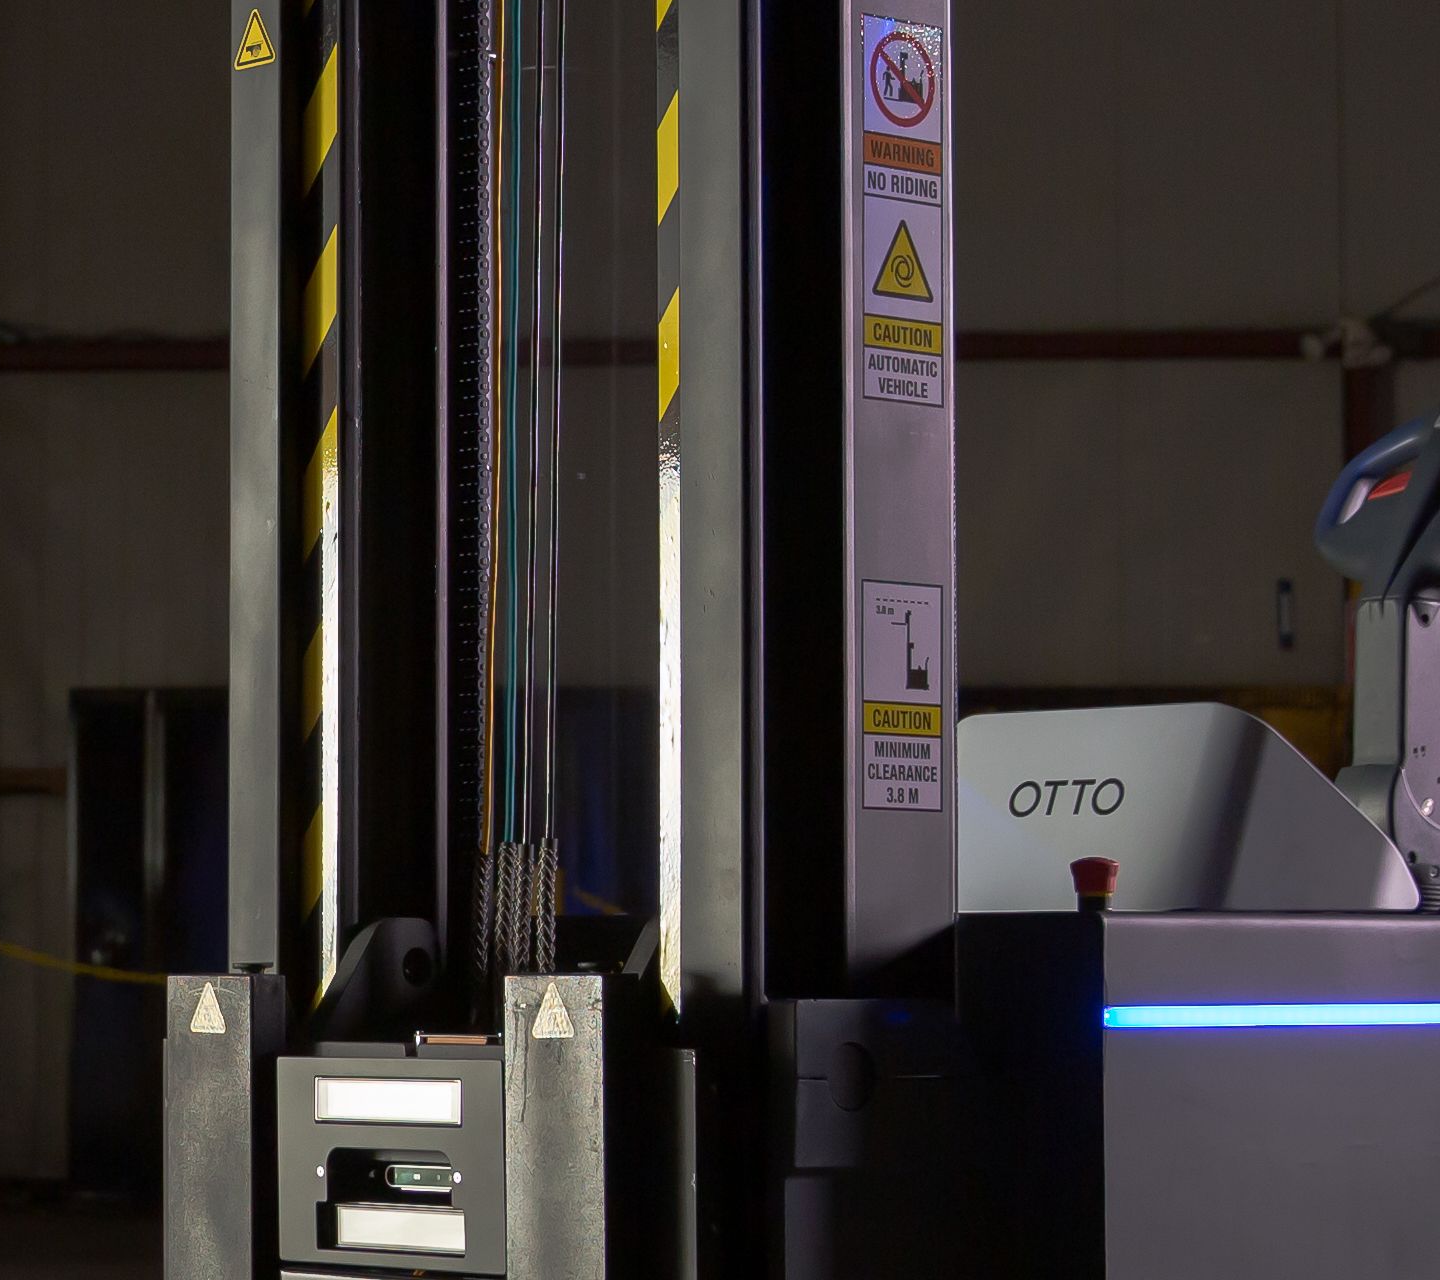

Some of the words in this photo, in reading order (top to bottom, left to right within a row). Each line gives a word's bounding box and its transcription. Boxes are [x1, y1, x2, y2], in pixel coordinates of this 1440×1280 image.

[870, 139, 935, 168] WARNING
[867, 170, 886, 190] NO
[891, 174, 938, 199] RIDING
[873, 322, 932, 348] CAUTION
[868, 353, 938, 378] AUTOMATIC
[878, 376, 929, 399] VEHICLE
[872, 708, 932, 730] CAUTION
[874, 740, 931, 760] MINIMUM
[867, 763, 938, 783] CLEARANCE
[886, 787, 905, 804] 3.8
[908, 787, 919, 804] M
[1009, 778, 1125, 818] OTTO
